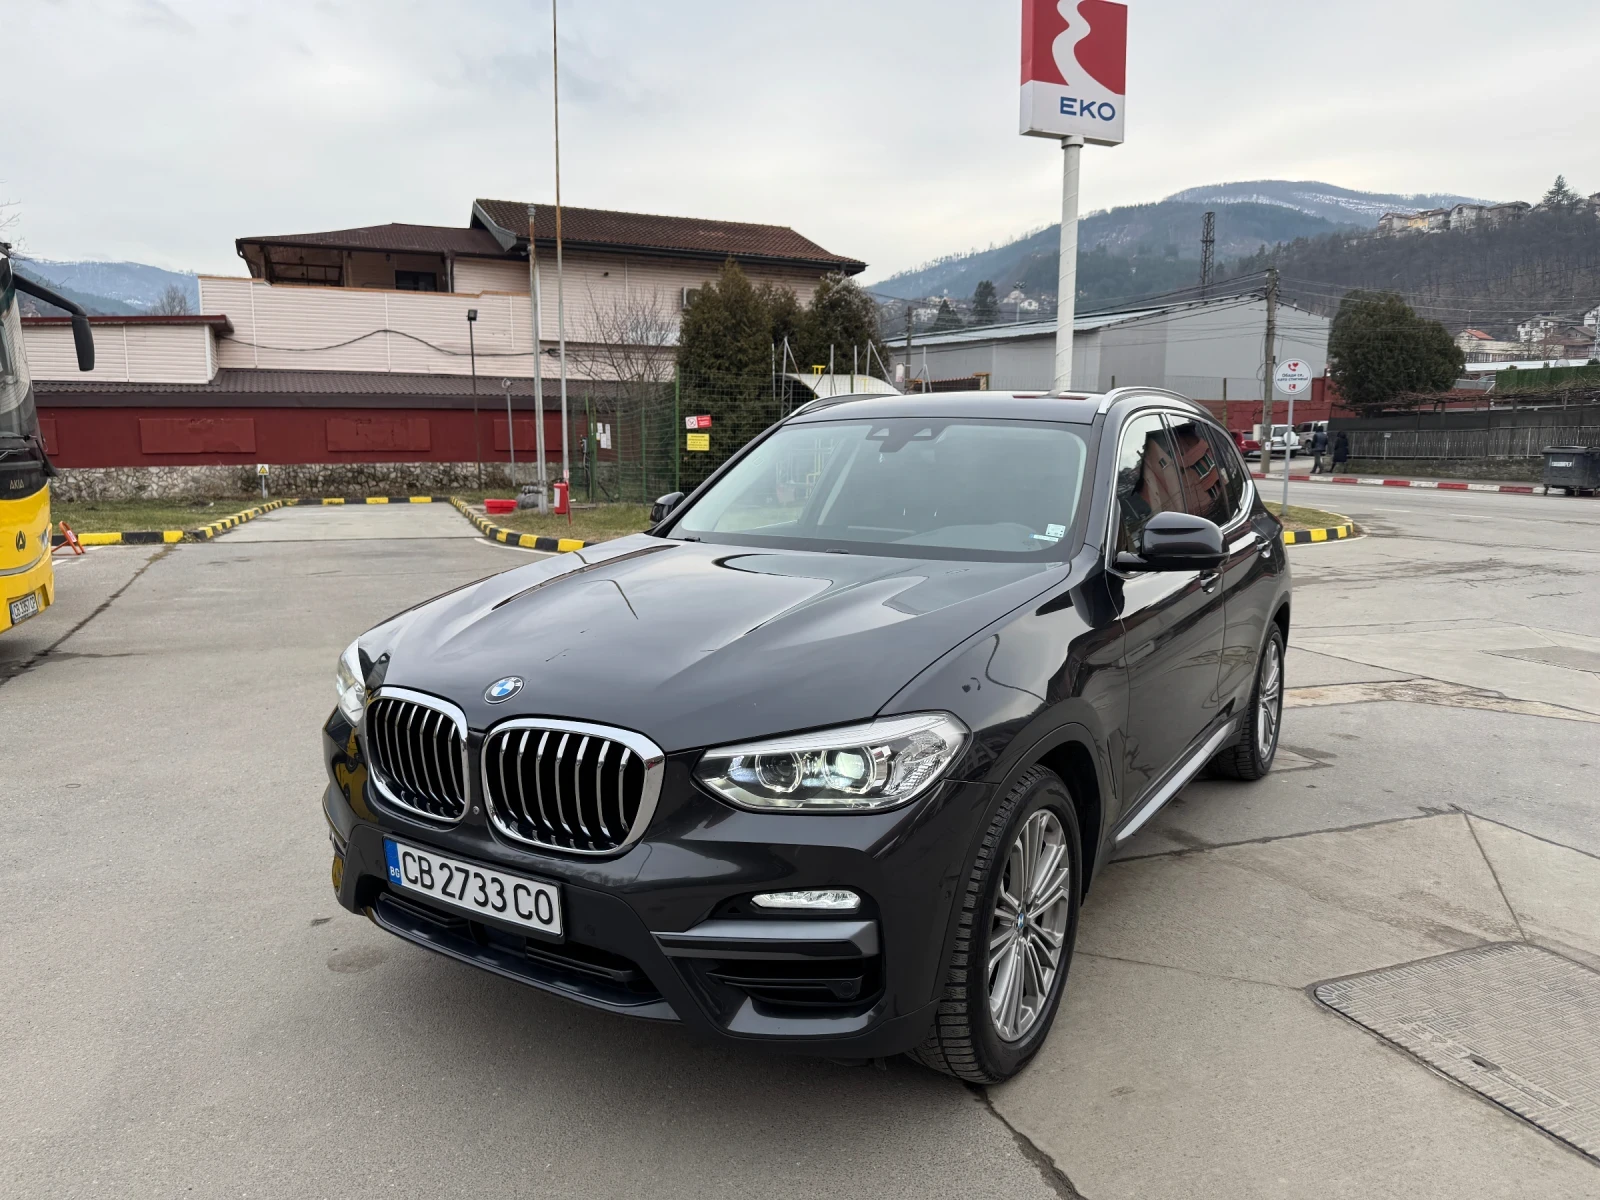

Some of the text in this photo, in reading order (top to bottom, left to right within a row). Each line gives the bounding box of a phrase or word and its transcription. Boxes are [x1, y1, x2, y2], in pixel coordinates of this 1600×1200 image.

[1060, 96, 1116, 121] EKO
[10, 479, 24, 489] AKIA
[390, 866, 400, 878] BG
[402, 851, 554, 925] CB 2733 CO
